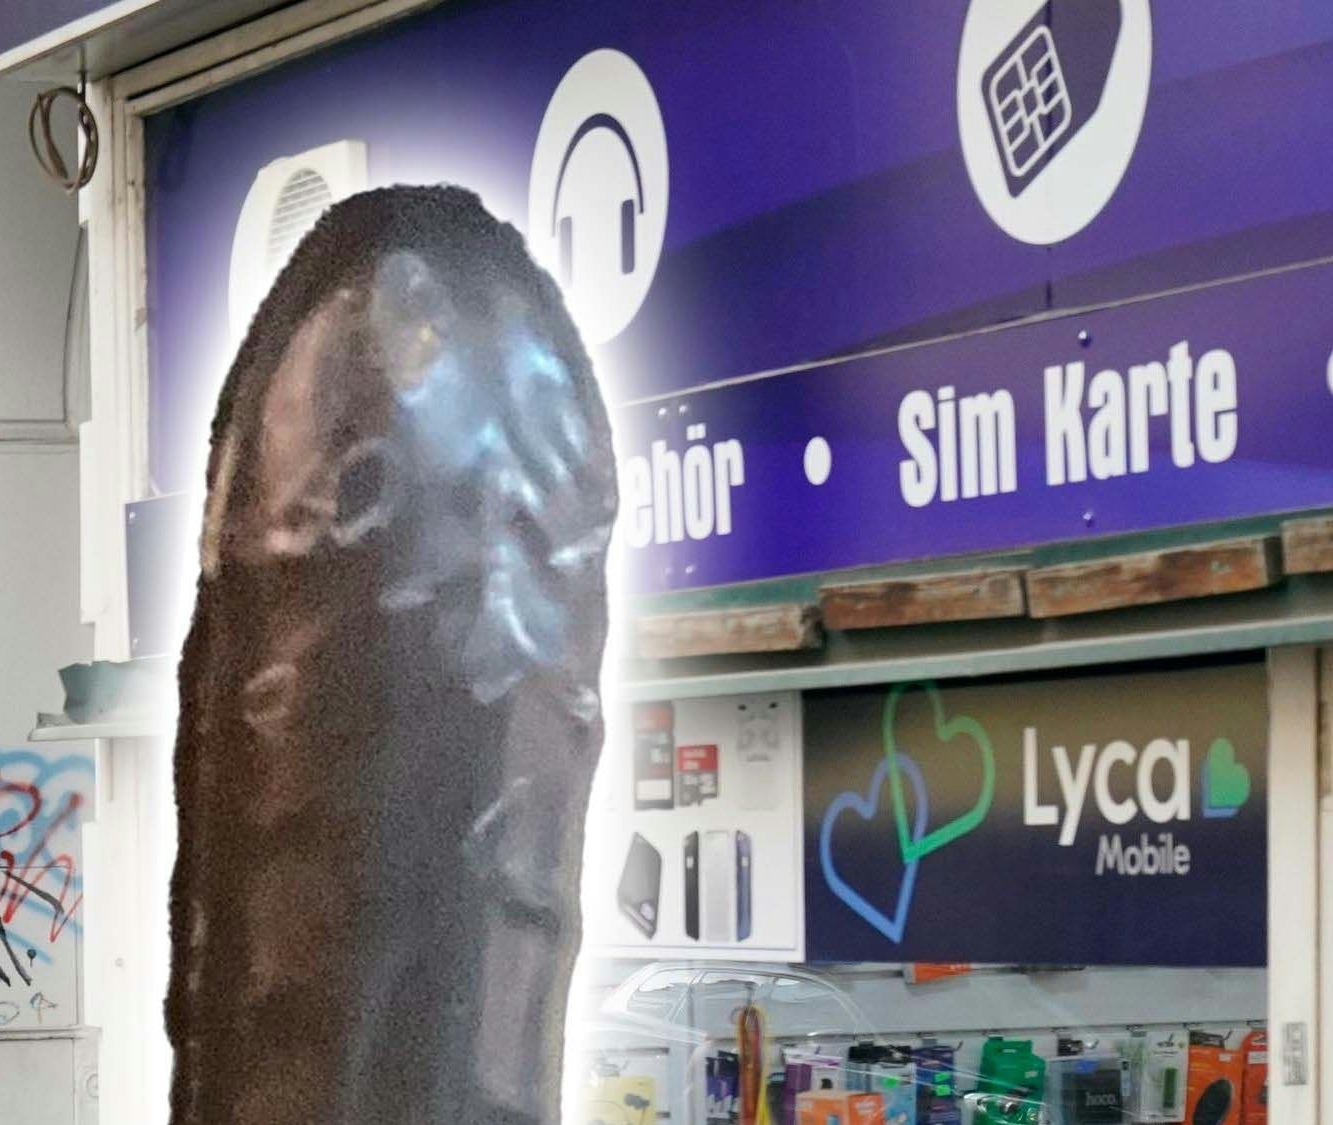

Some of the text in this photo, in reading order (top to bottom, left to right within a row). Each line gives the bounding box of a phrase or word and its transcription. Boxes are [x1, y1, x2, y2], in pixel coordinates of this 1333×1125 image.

[898, 340, 1239, 508] Sim Karte
[625, 425, 745, 549] ehör
[1023, 727, 1191, 846] Lyca
[1095, 833, 1191, 876] Mobile
